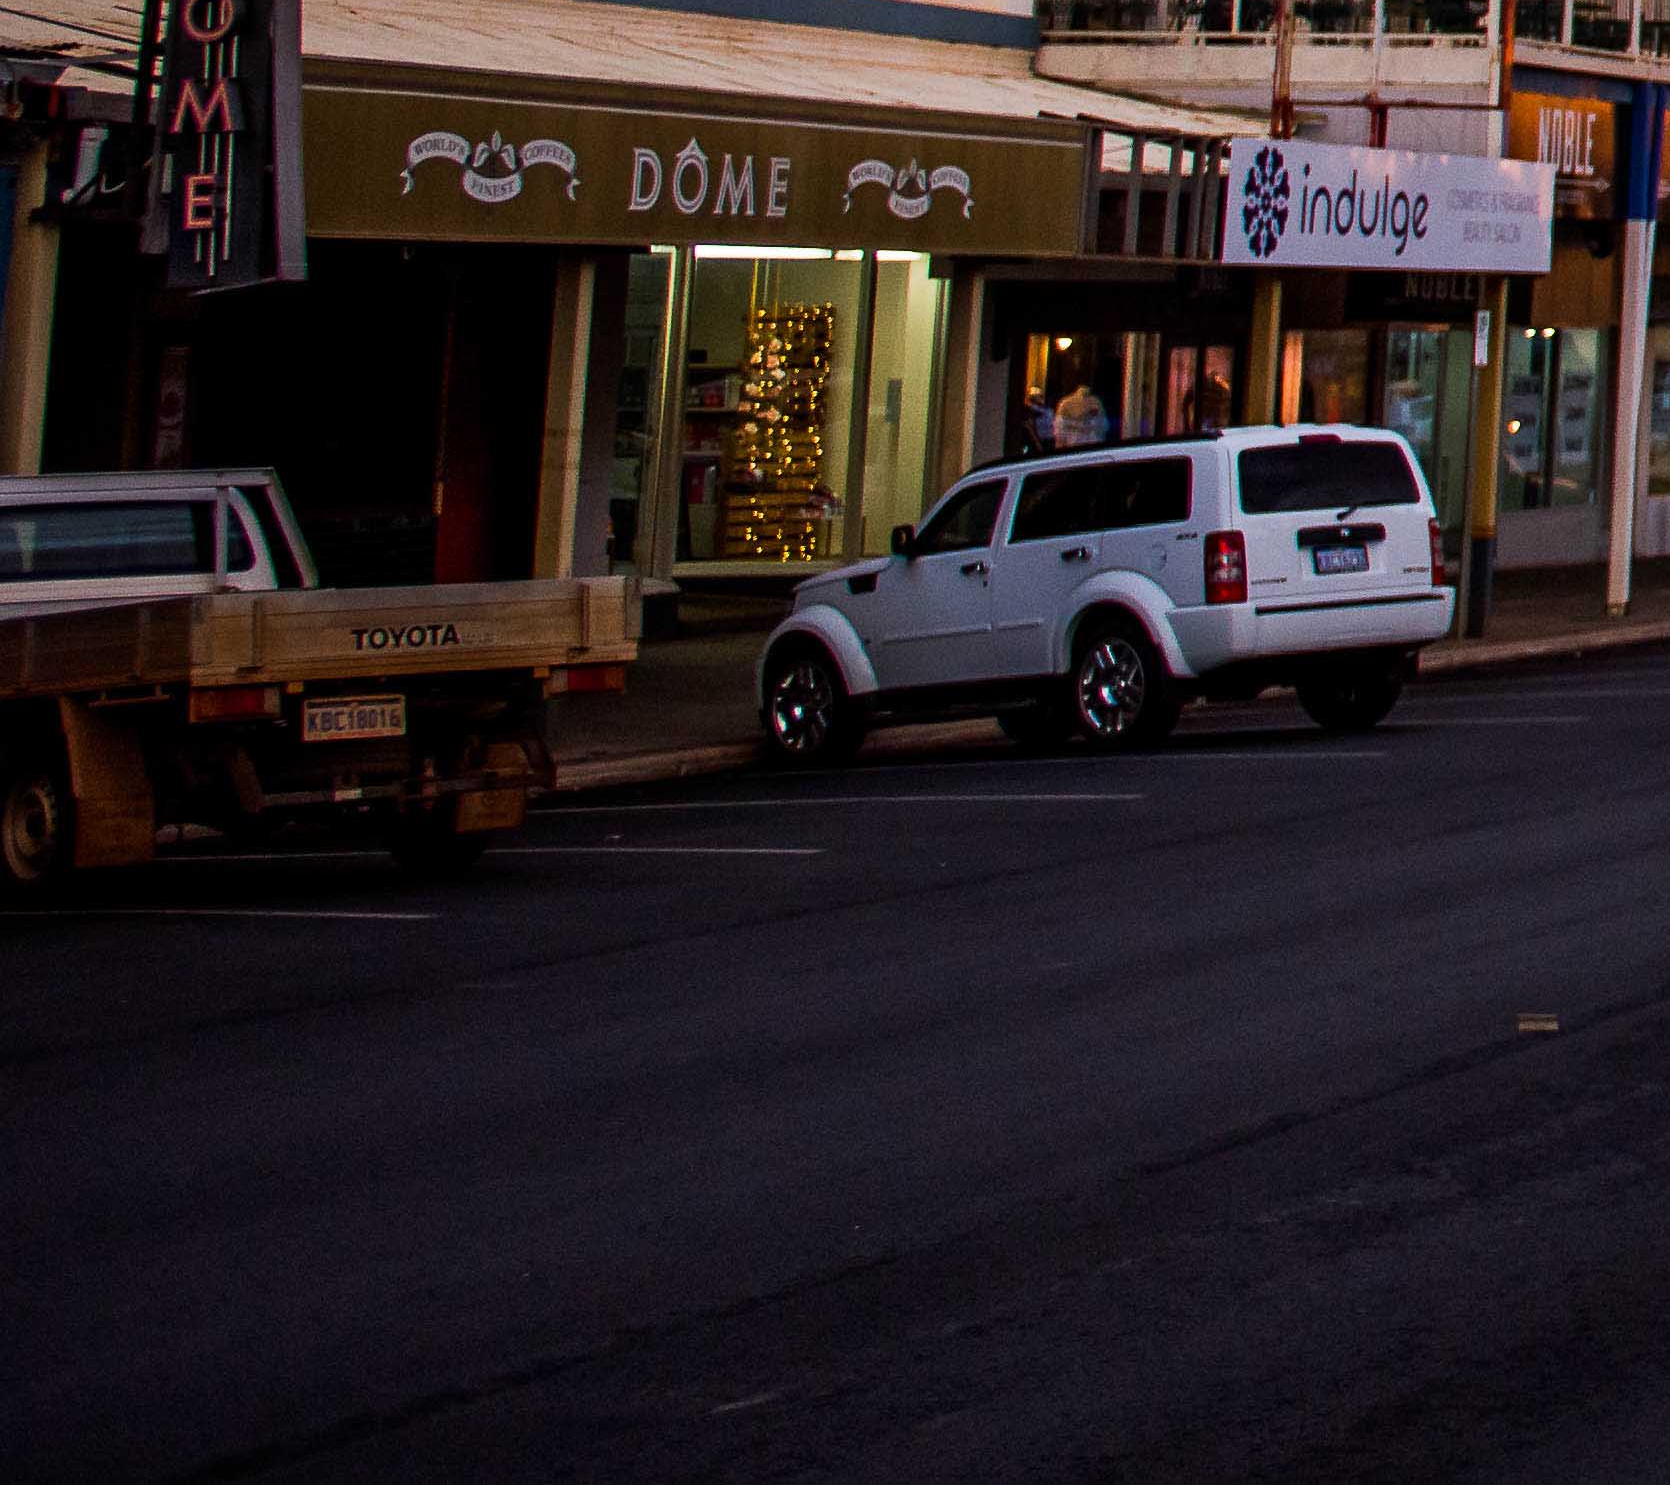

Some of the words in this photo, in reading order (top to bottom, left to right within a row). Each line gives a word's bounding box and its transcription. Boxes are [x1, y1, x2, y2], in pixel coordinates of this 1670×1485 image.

[629, 135, 792, 217] DÔME
[1538, 105, 1598, 177] NOBLE
[1300, 163, 1429, 256] indulge
[352, 623, 461, 651] TOYOTA
